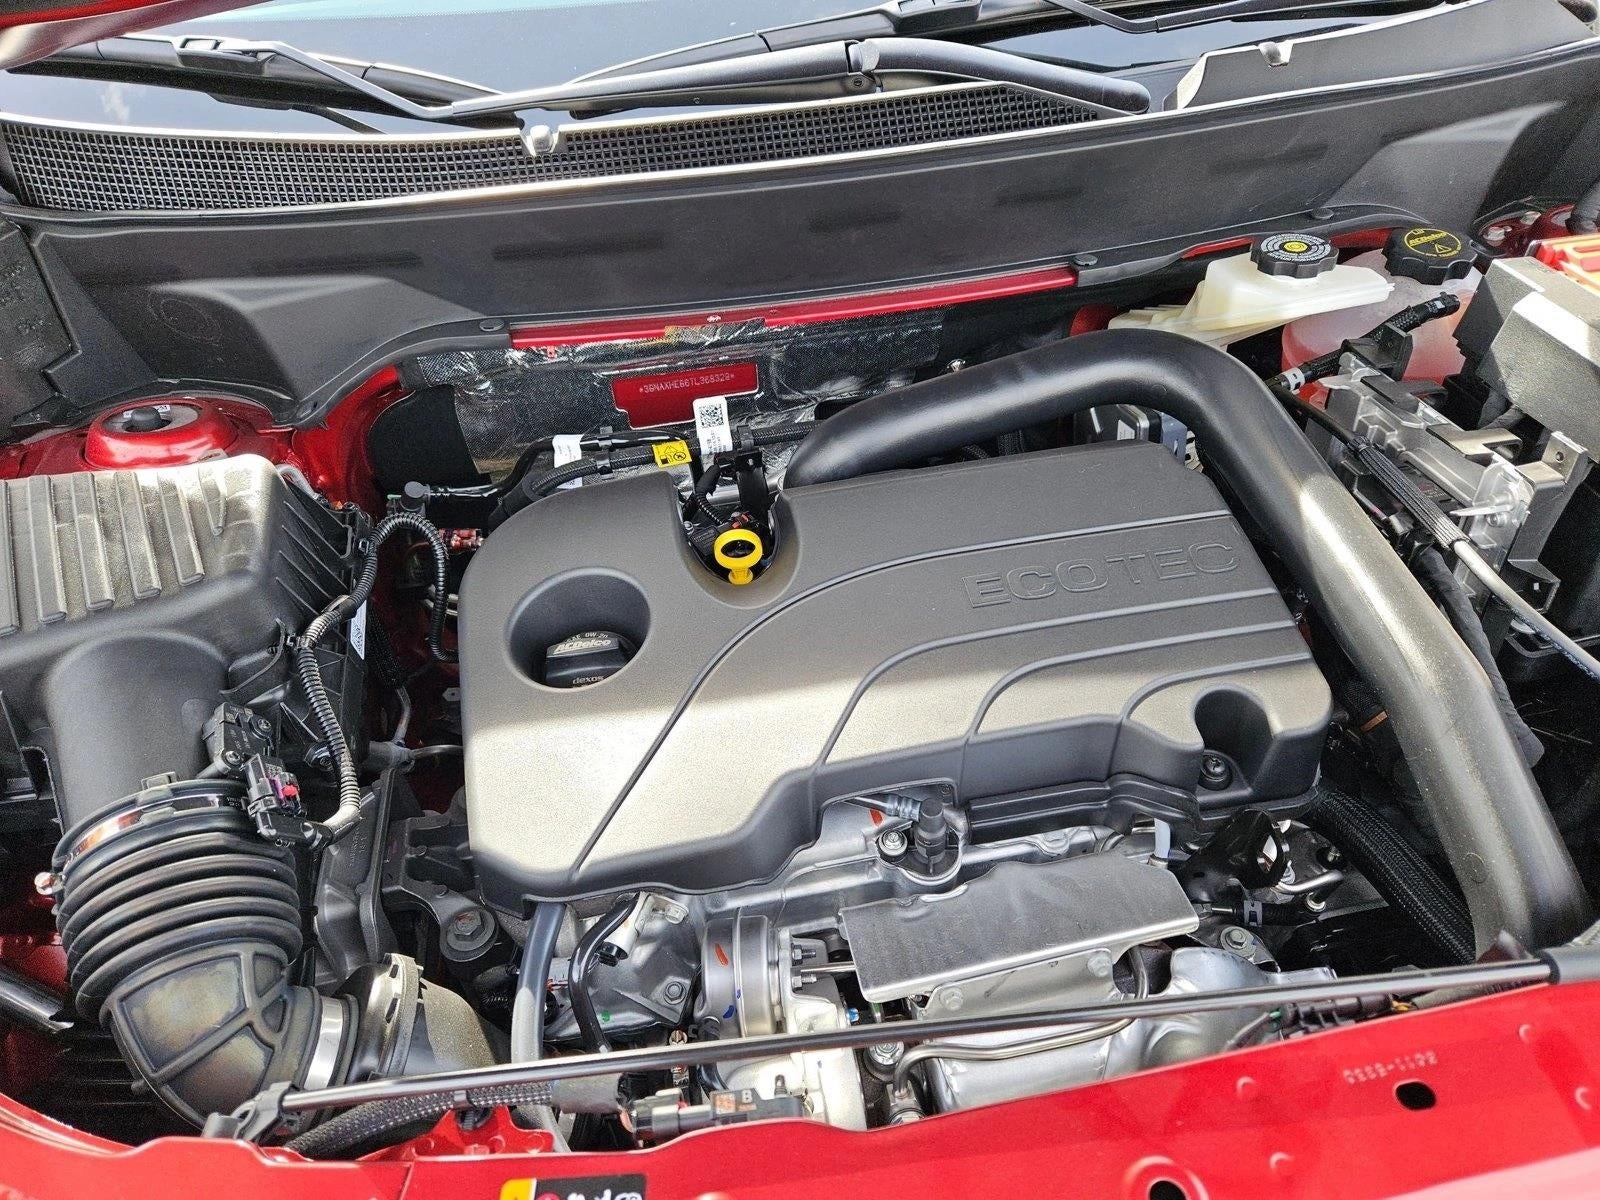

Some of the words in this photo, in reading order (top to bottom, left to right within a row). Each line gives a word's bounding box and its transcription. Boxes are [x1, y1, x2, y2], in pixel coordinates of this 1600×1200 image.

[962, 543, 1238, 609] ECOTEC
[553, 639, 612, 655] ACDelco
[572, 676, 604, 685] dexos
[741, 1089, 752, 1104] B
